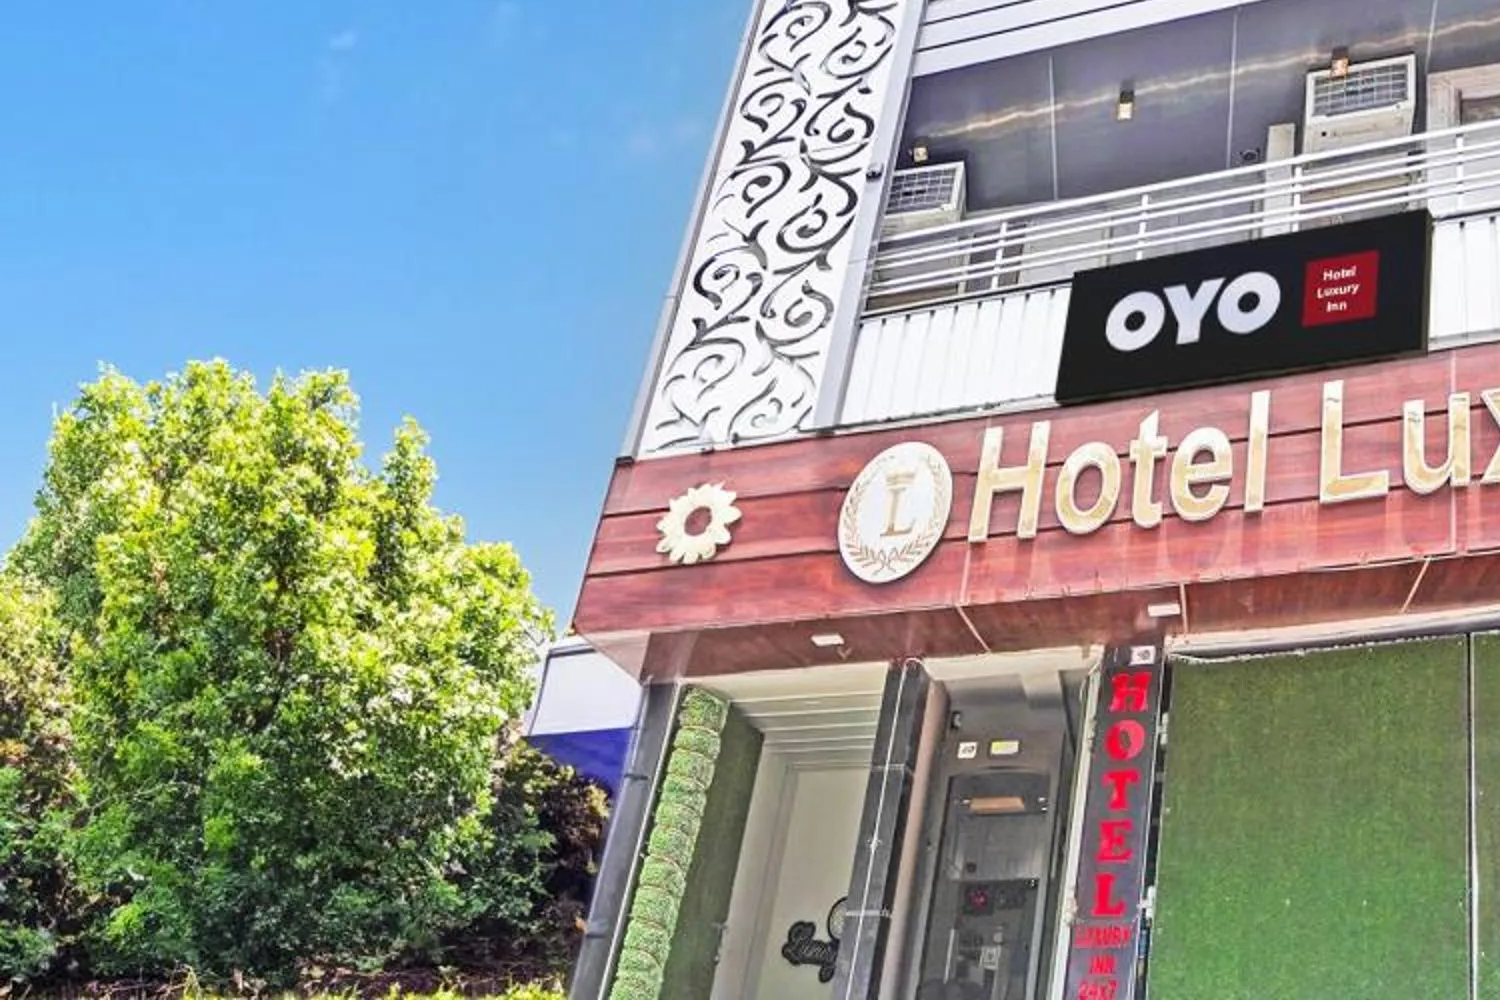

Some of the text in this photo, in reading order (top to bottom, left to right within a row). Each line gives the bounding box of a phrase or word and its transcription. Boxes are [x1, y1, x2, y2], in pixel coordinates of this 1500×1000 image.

[1317, 282, 1360, 299] Luxury
[1323, 266, 1357, 281] Hotel
[1105, 271, 1281, 351] OYO
[1326, 300, 1347, 312] Inn
[967, 390, 1271, 544] Hotel
[1092, 671, 1152, 918] HOTEL
